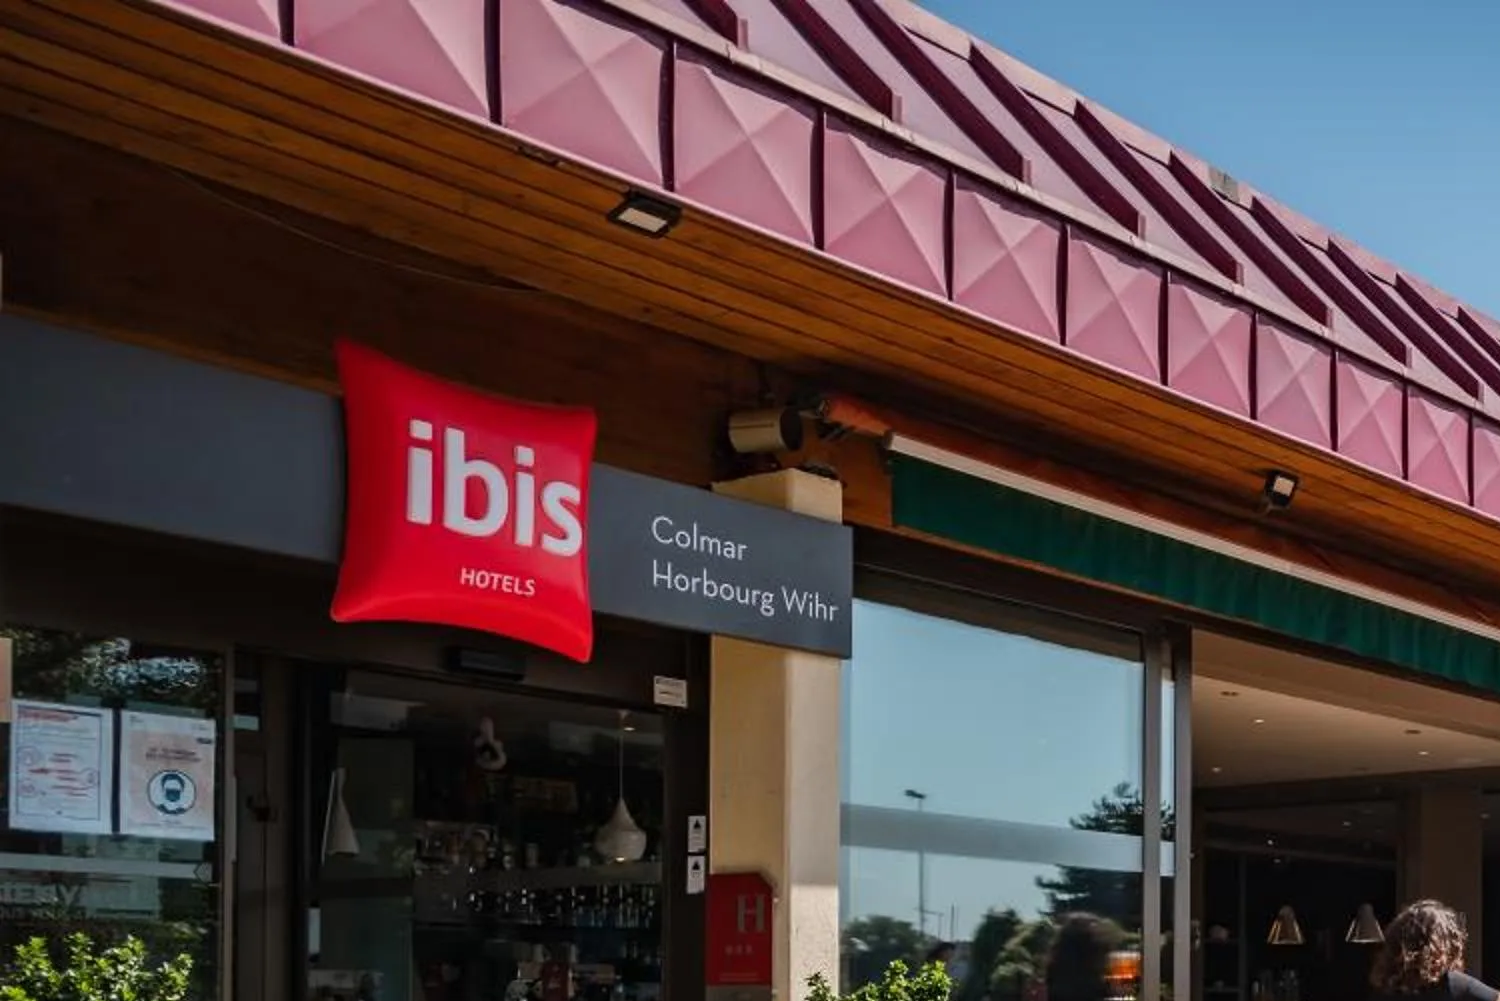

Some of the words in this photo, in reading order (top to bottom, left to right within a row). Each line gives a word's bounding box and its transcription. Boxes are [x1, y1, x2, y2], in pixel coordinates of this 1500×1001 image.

[406, 418, 583, 557] ibis
[652, 515, 748, 560] Colmar
[459, 567, 537, 597] HOTELS
[653, 559, 775, 617] Horbourg
[781, 584, 839, 622] Wihr
[737, 893, 766, 933] H
